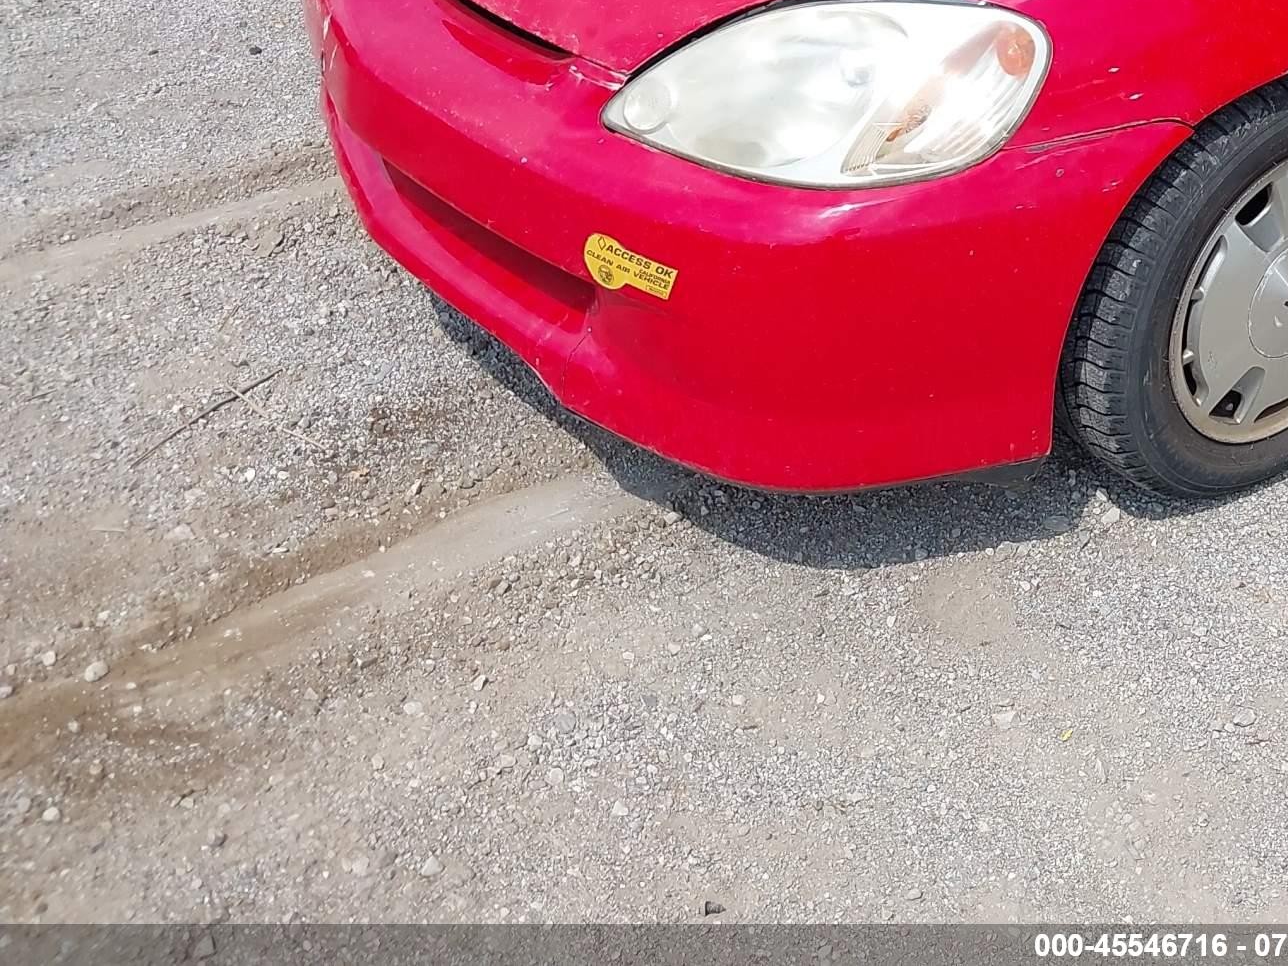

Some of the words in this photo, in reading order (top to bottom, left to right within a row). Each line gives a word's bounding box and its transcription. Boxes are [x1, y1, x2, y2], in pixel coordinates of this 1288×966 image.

[586, 249, 614, 266] CLEAN
[616, 264, 630, 274] AIR
[634, 270, 670, 290] VEHICLE
[606, 244, 652, 270] ACCESS
[655, 265, 674, 279] OK
